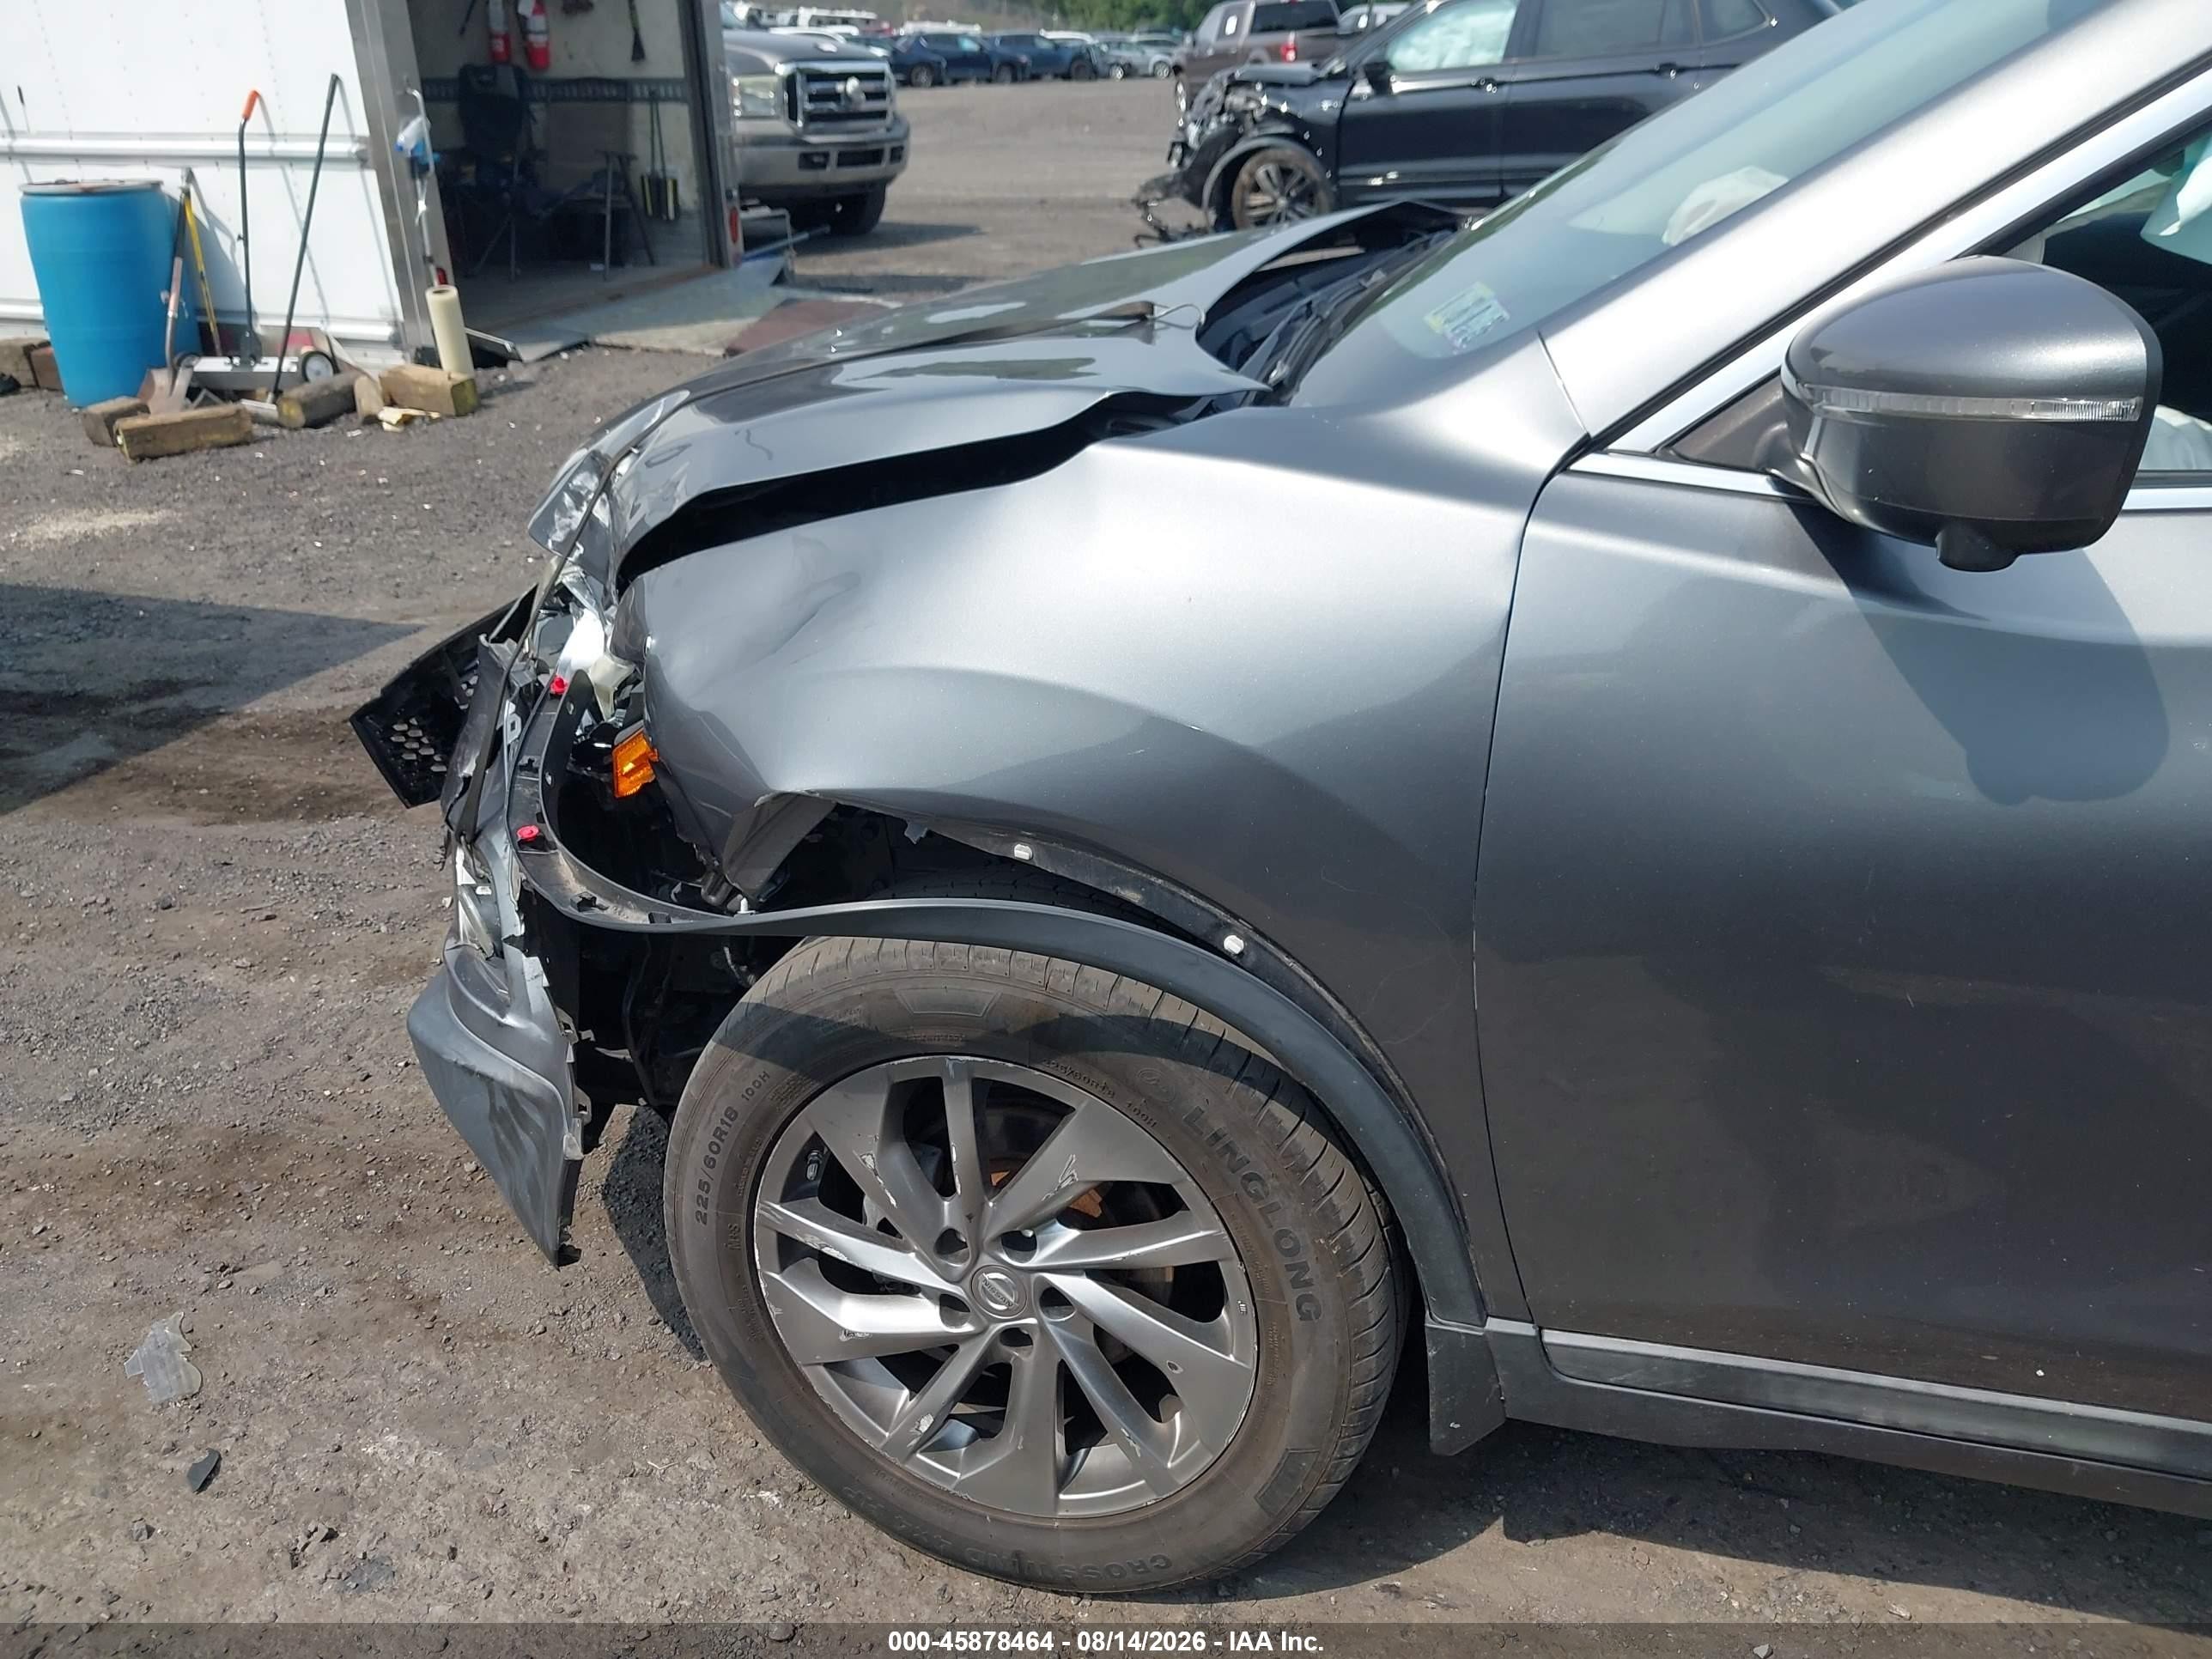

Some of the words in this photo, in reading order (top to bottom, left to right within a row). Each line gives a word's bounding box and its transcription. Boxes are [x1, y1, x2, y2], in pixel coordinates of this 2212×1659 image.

[694, 1105, 739, 1226] 225/60R18
[741, 1071, 771, 1102] 100H
[1182, 1105, 1323, 1322] LINGLONG
[981, 1278, 1014, 1308] NISSAN
